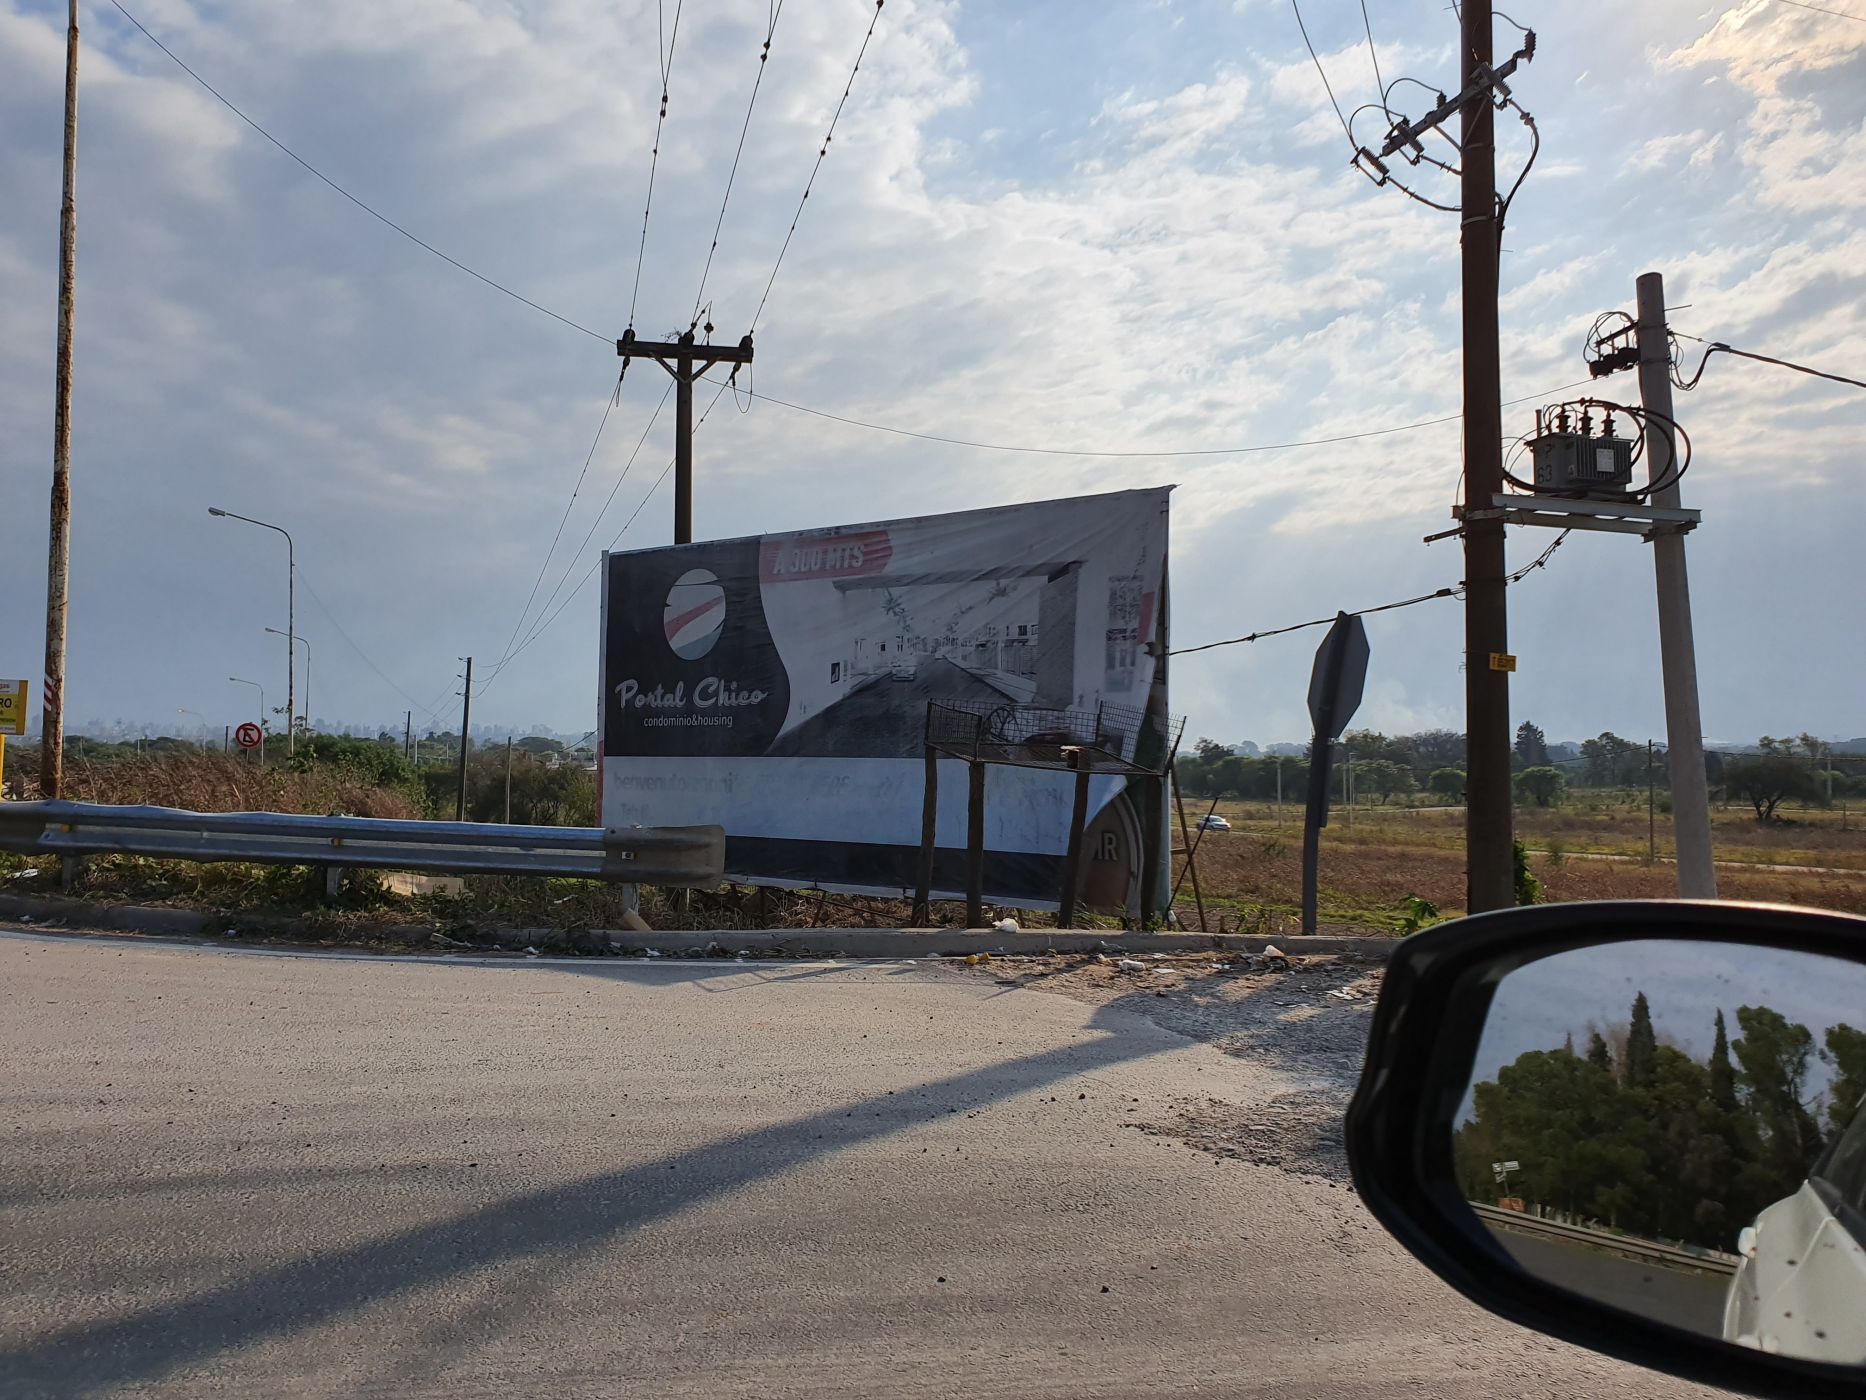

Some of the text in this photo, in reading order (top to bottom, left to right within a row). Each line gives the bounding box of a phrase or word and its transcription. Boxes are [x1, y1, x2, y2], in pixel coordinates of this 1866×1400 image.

[615, 676, 769, 709] Portal Chico
[643, 714, 733, 728] condominio&housing
